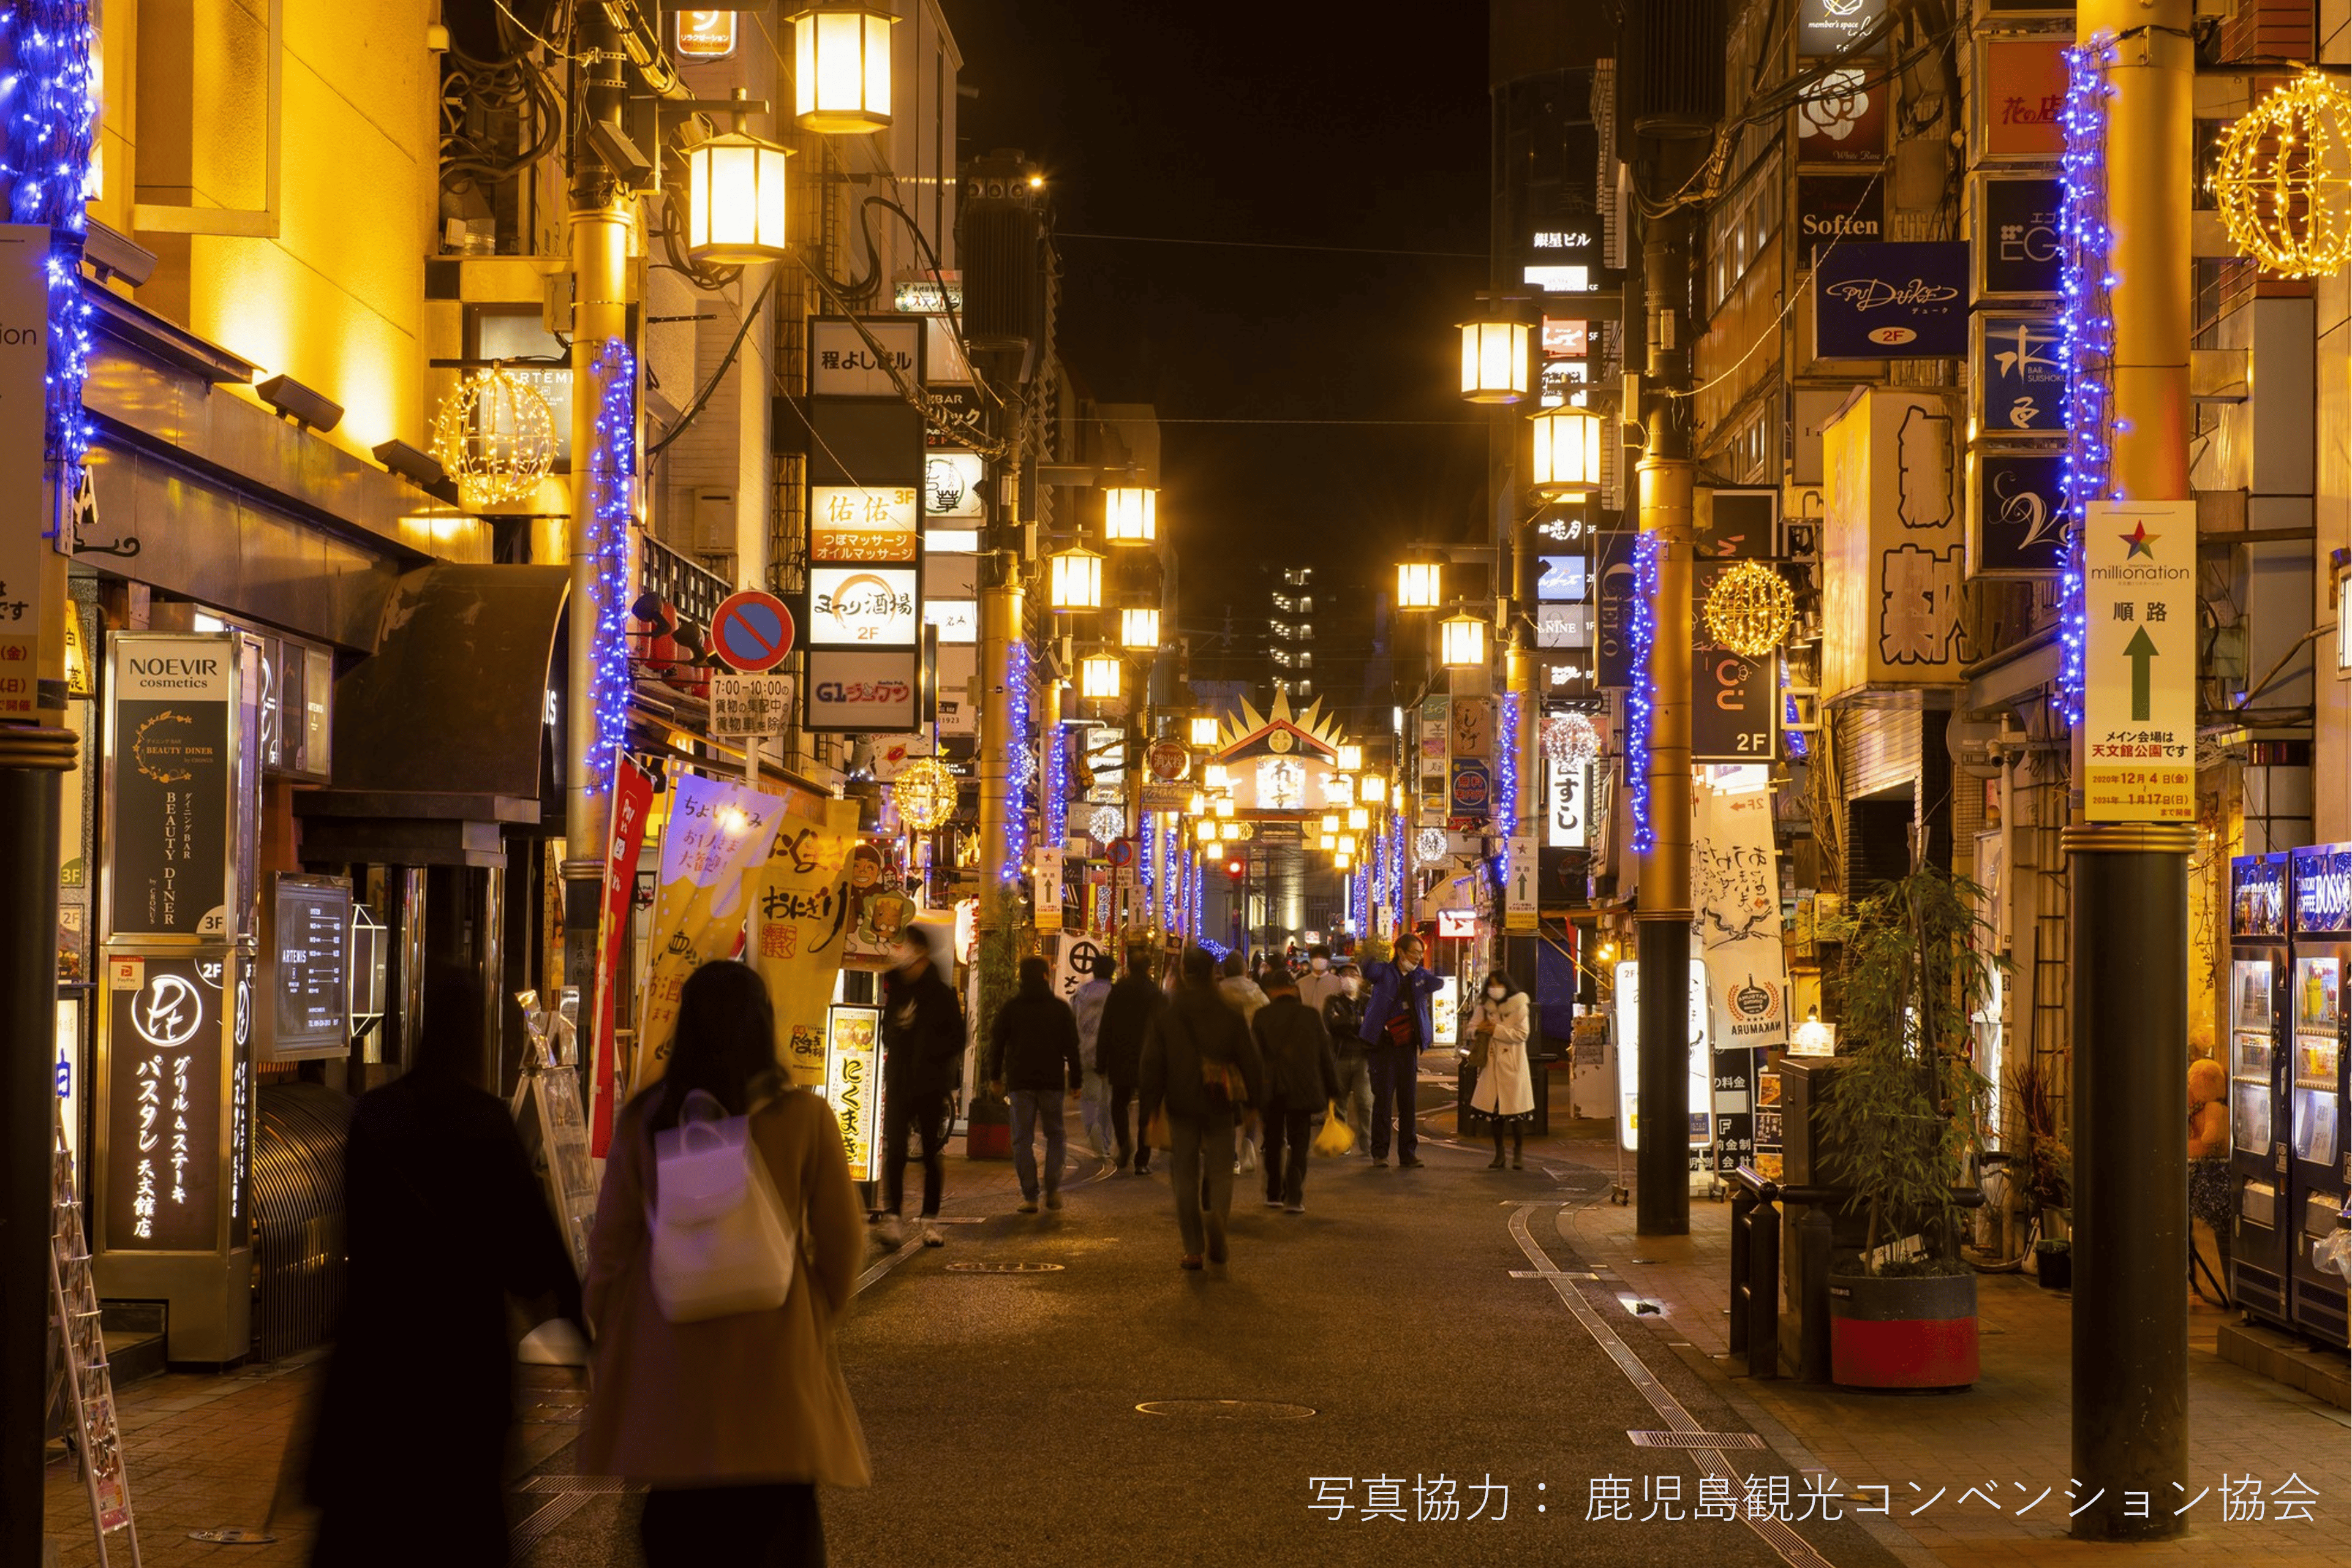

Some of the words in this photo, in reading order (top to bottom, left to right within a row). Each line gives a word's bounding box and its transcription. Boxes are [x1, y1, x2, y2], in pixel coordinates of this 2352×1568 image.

[1803, 214, 1879, 235] Soften
[1534, 232, 1591, 247] 銀星ビル
[1883, 331, 1905, 342] 2F
[894, 491, 915, 505] 3F
[828, 494, 892, 523] 佑佑
[1586, 525, 1597, 534] 3F
[823, 534, 908, 547] つぼマッサージ
[817, 548, 913, 560] オイルマッサージ
[2092, 565, 2190, 579] millionation
[814, 592, 913, 616] まつり酒場
[2113, 601, 2168, 622] 順路
[858, 627, 880, 640] 2F
[130, 658, 217, 676] NOEVIR
[140, 677, 208, 688] cosmetics
[715, 717, 786, 731] 貨物車を除く
[1737, 734, 1766, 752] 2F
[2106, 731, 2174, 743] メイン会場は
[2092, 744, 2188, 758] 天文館公園です
[184, 792, 192, 832] ダイニング
[165, 792, 176, 861] BEAUTY
[62, 869, 80, 883] 3F
[164, 867, 176, 925] DINER
[2316, 874, 2342, 914] BOSS
[205, 916, 224, 929] 3F
[203, 963, 222, 978] 2F
[172, 1056, 192, 1204] グリル&ステーキ
[133, 1159, 155, 1238] 天文館店
